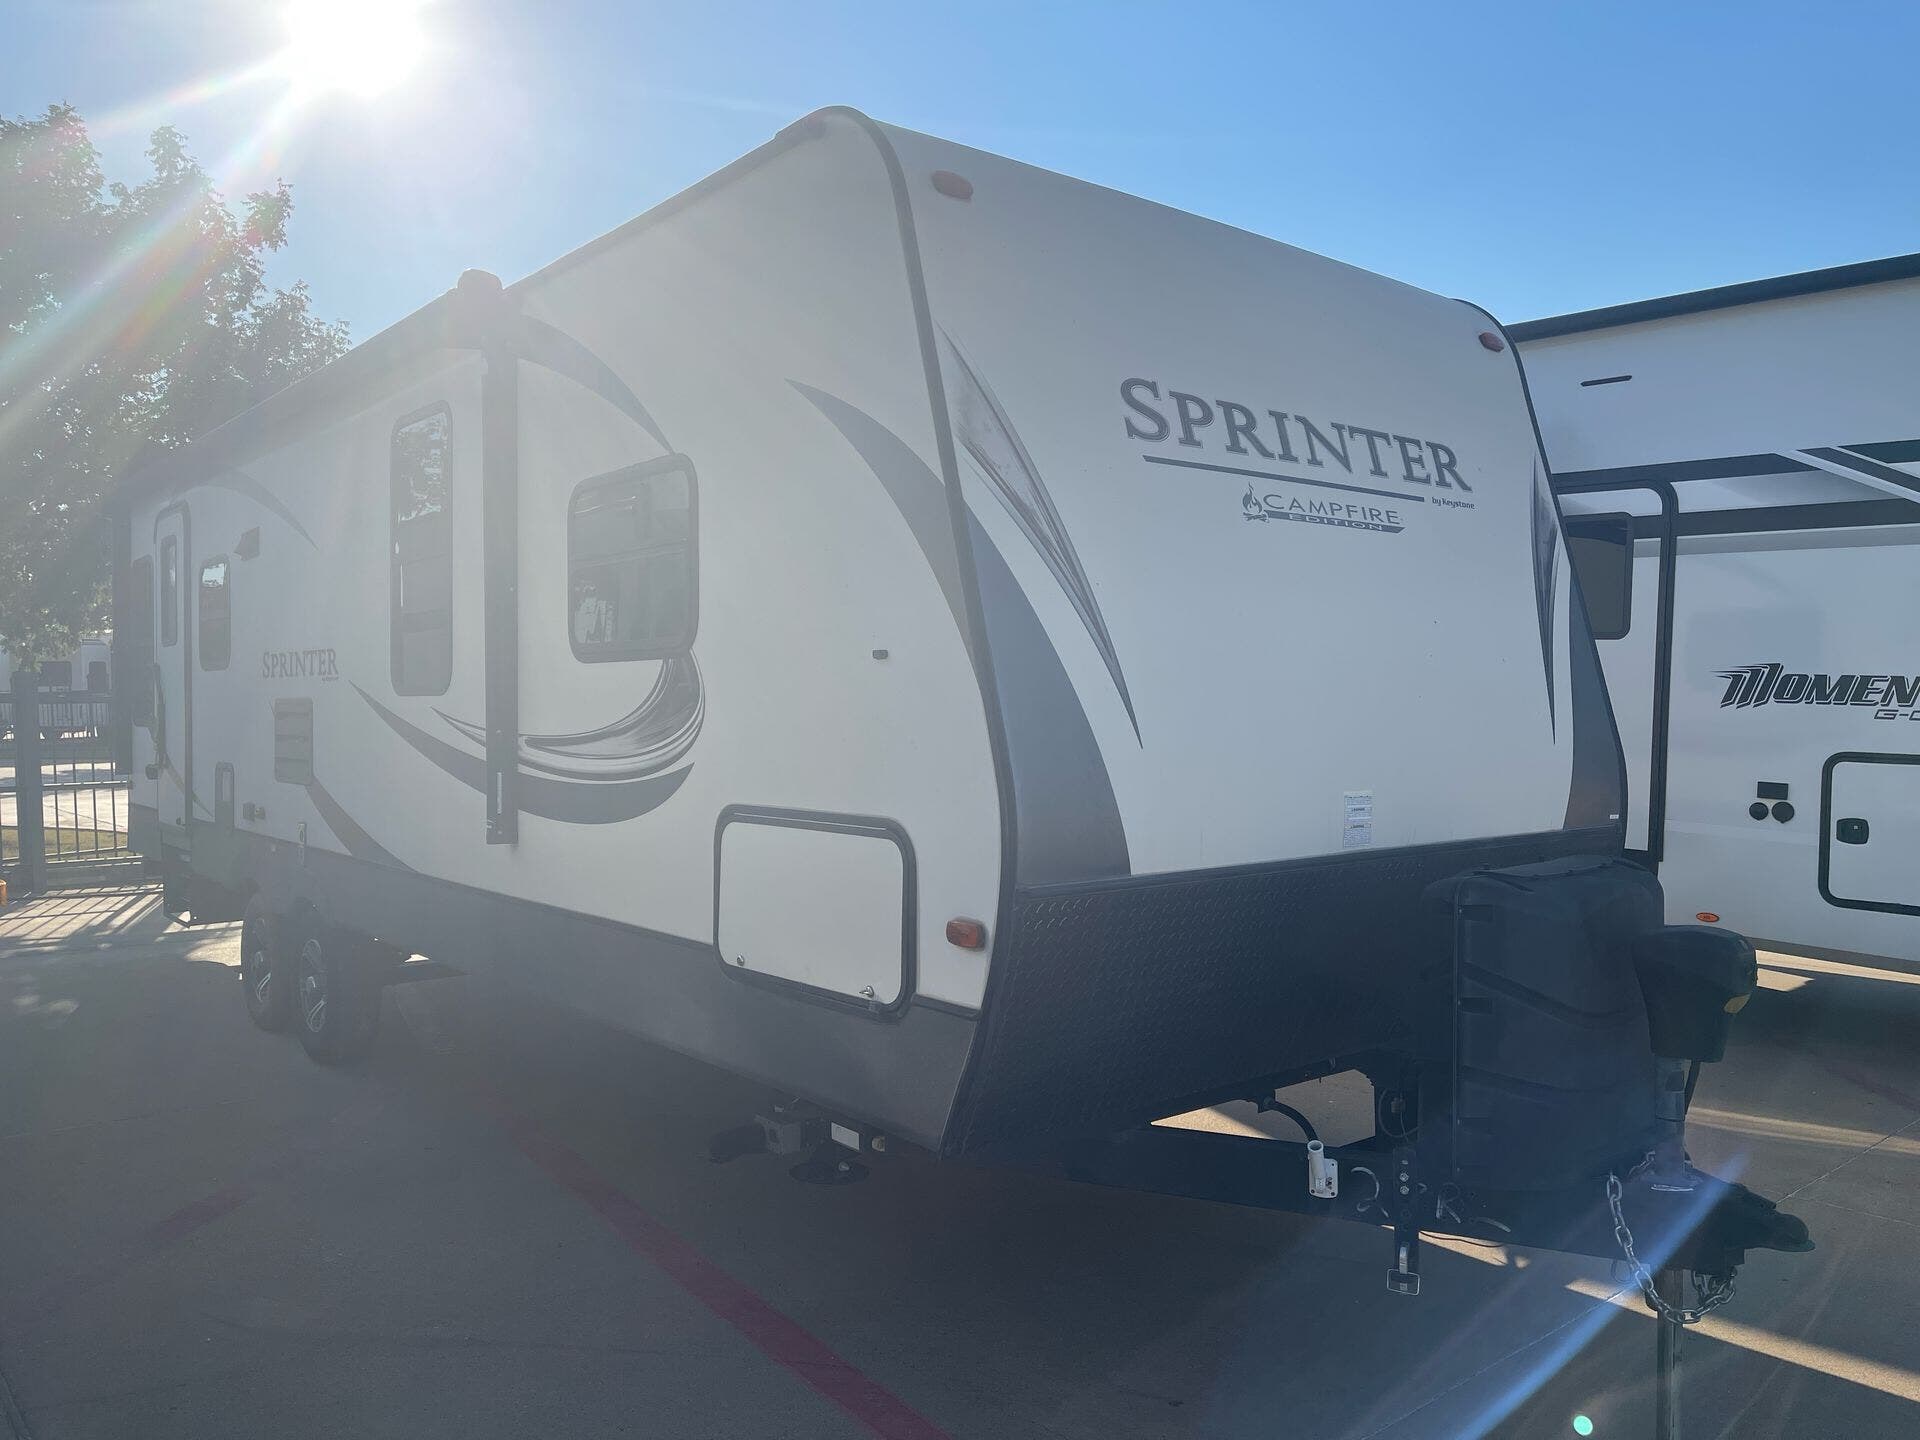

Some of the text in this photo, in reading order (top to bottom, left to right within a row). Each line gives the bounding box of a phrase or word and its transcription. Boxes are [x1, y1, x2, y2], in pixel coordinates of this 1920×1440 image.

[1120, 377, 1473, 492] SPRINTER
[1262, 494, 1402, 525] CAMPFIRE
[1288, 513, 1384, 532] EDITION
[262, 649, 339, 678] SPRINTER
